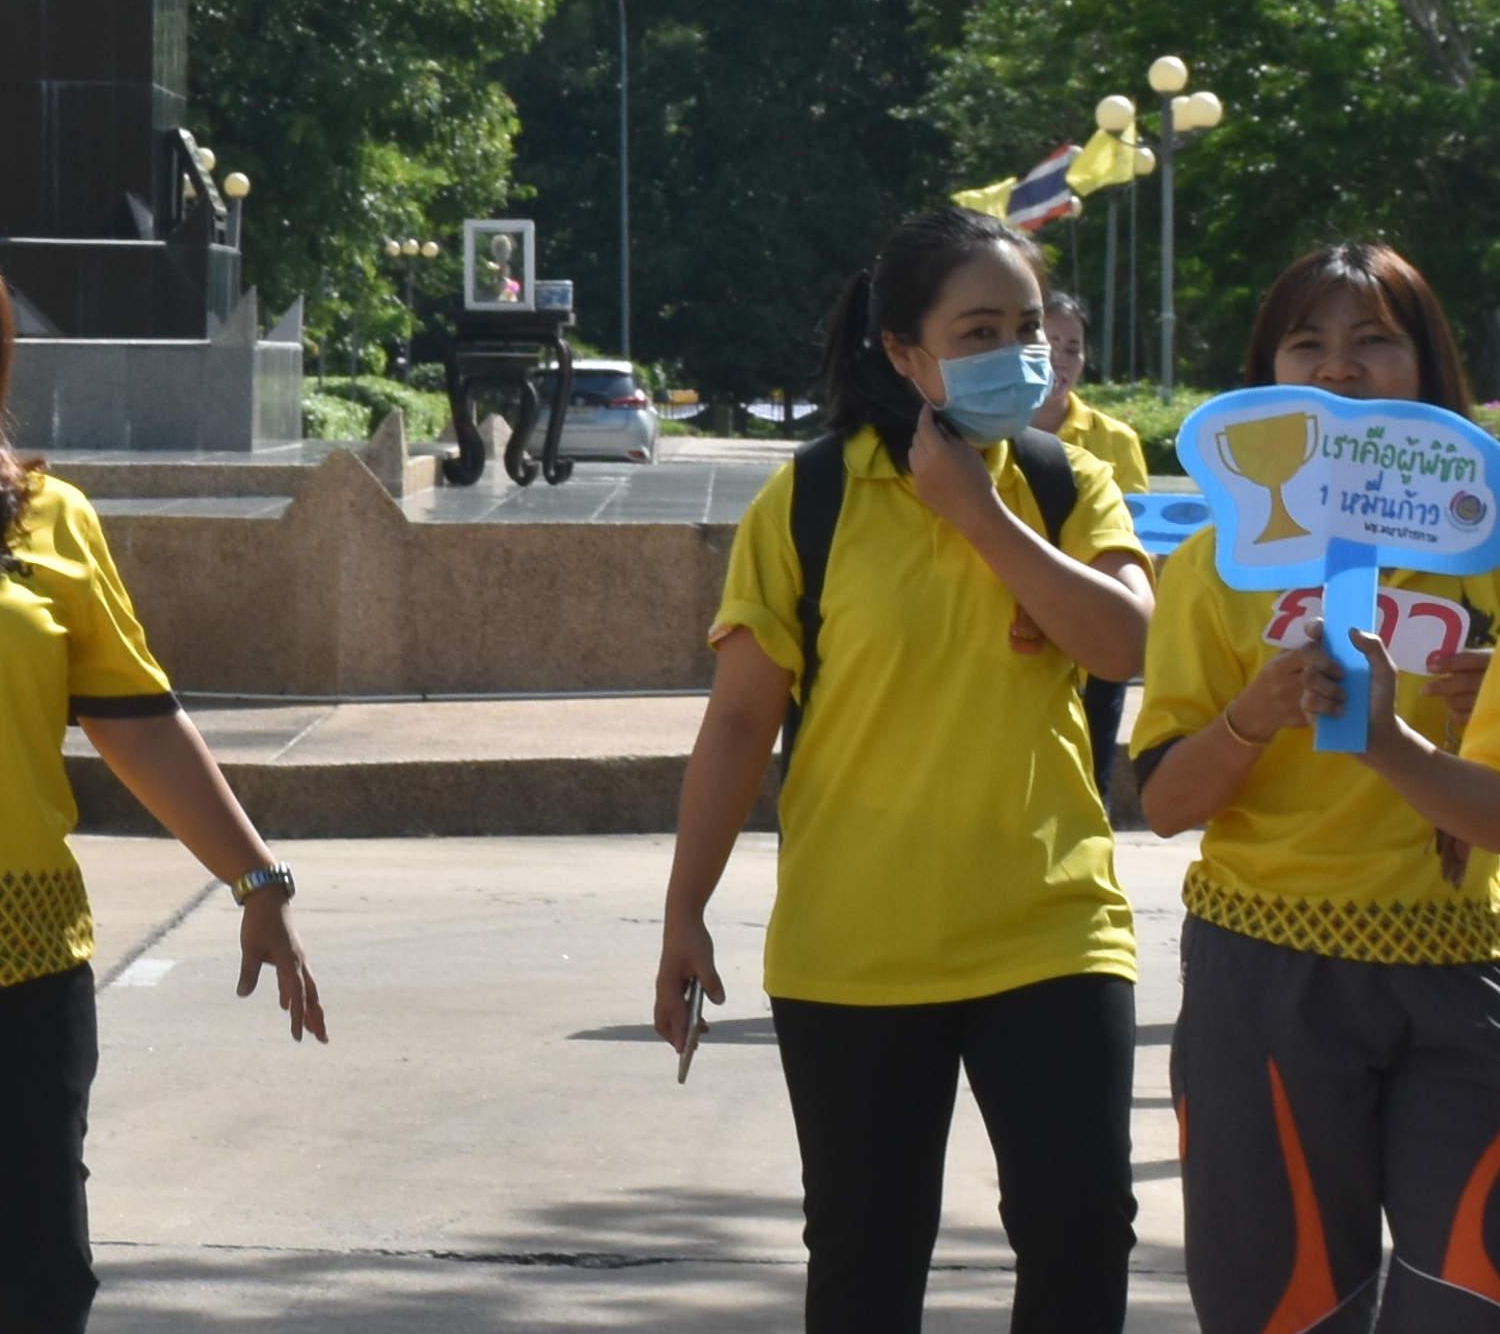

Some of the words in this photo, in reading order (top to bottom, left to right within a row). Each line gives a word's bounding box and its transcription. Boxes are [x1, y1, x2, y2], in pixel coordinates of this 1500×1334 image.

[1322, 426, 1477, 485] เราคือผู้พิชิต
[1320, 484, 1329, 506] 1
[1340, 470, 1440, 526] หมื่นก้าว
